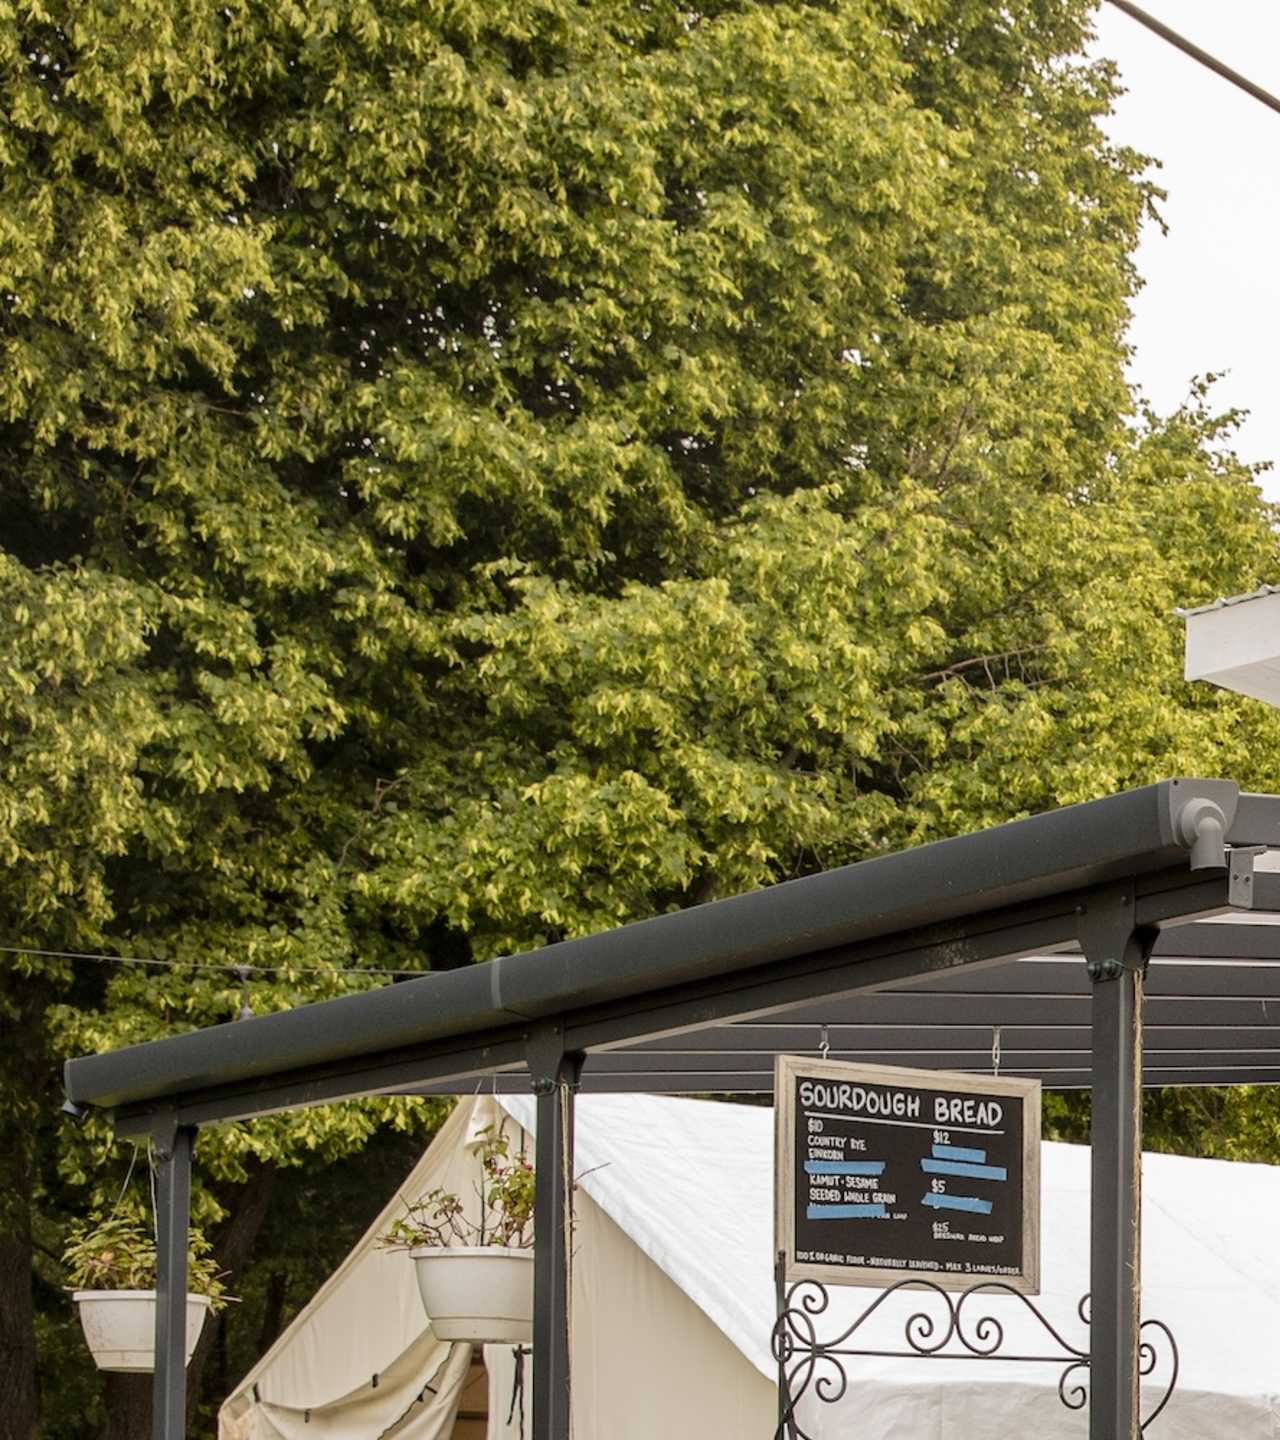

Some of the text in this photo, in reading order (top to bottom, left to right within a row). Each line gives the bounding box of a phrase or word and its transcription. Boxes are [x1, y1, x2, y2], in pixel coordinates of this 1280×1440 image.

[800, 1082, 1003, 1127] SOURDOUGH BREAD
[808, 1134, 867, 1151] COUNTRY RYE
[933, 1129, 951, 1146] $12
[931, 1178, 946, 1194] $5
[809, 1188, 841, 1202] SEEDED
